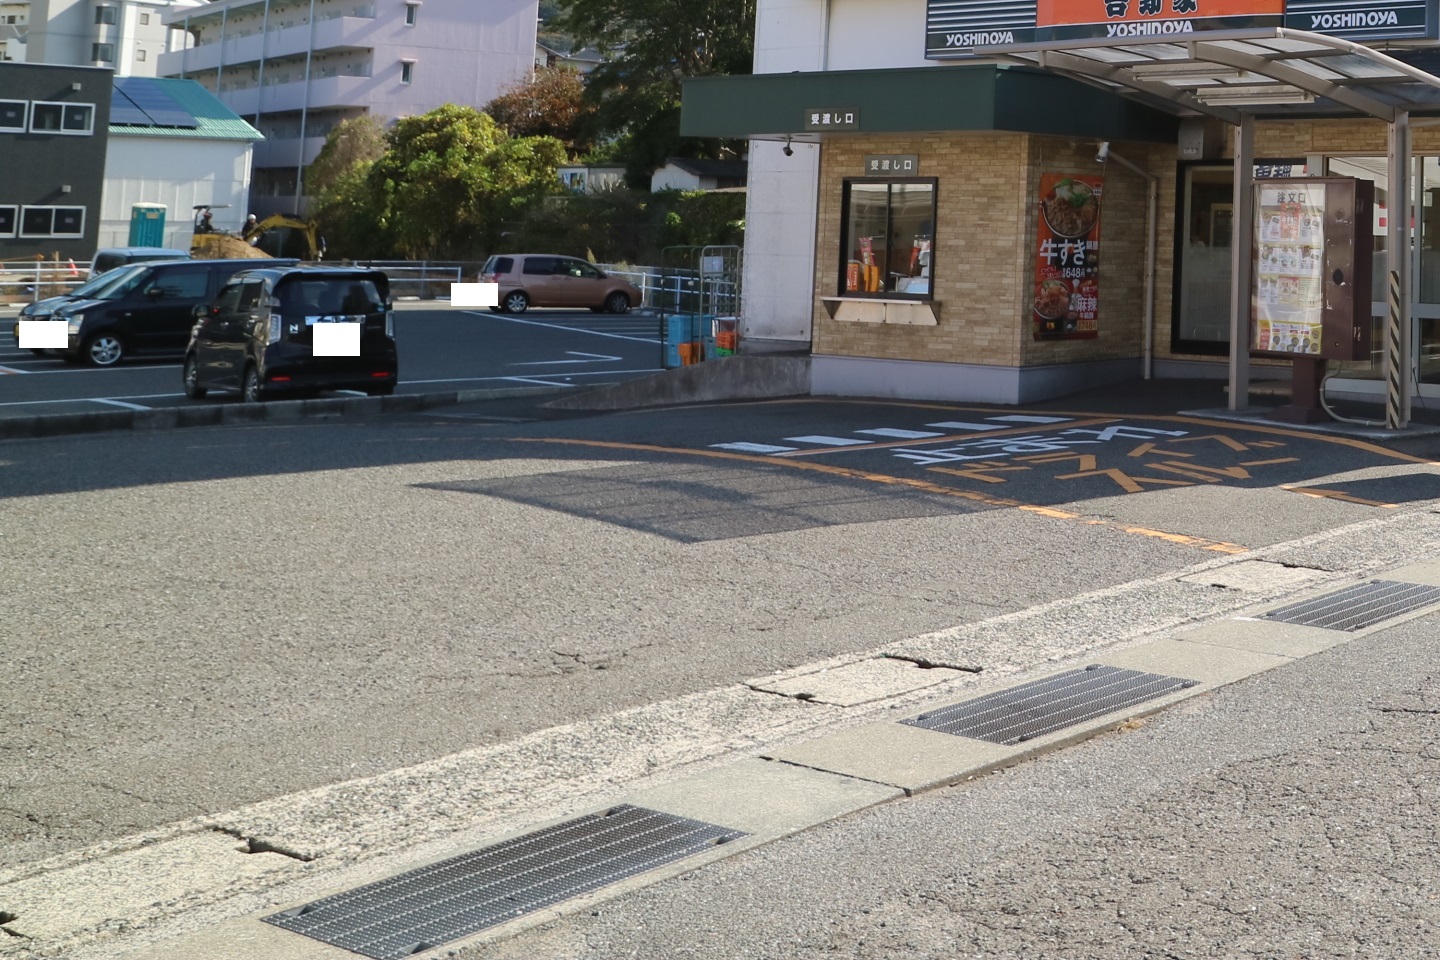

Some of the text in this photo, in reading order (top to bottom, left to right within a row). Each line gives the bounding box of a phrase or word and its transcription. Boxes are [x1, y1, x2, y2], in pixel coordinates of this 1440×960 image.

[1311, 10, 1398, 29] YOSHINOYA
[1106, 20, 1193, 38] YOSHINOYA
[946, 31, 1014, 47] YOSHINOYA
[811, 113, 854, 125] 受渡し口
[870, 159, 912, 171] 受渡し口
[1277, 191, 1306, 203] 注文口
[1039, 238, 1086, 266] 牛すき
[889, 425, 1189, 465] 止まれ
[925, 434, 1287, 483] ドライブ
[1054, 457, 1300, 493] スルー
